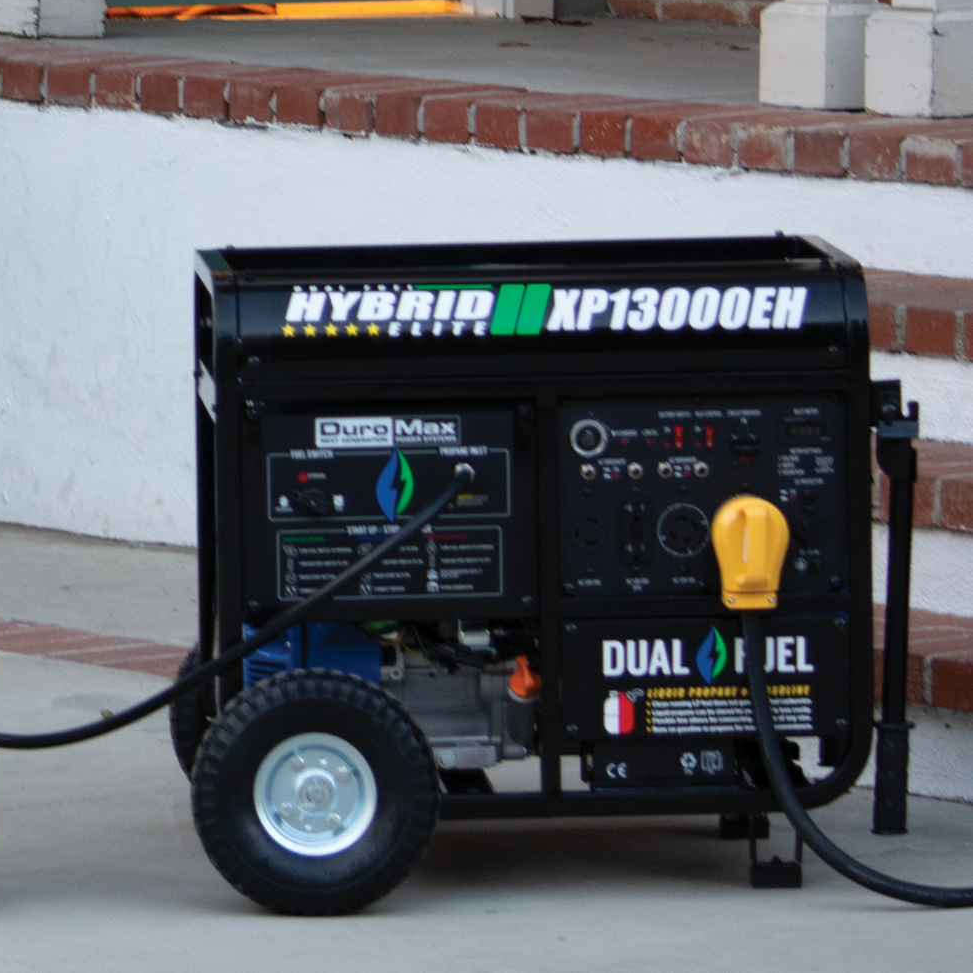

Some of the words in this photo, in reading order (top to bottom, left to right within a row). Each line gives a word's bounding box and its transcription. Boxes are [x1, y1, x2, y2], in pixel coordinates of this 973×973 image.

[285, 291, 495, 321] HYBRID
[546, 286, 807, 331] XP13000EH
[387, 320, 488, 337] ELITE
[602, 638, 690, 676] DUAL
[688, 685, 738, 698] PROPANE
